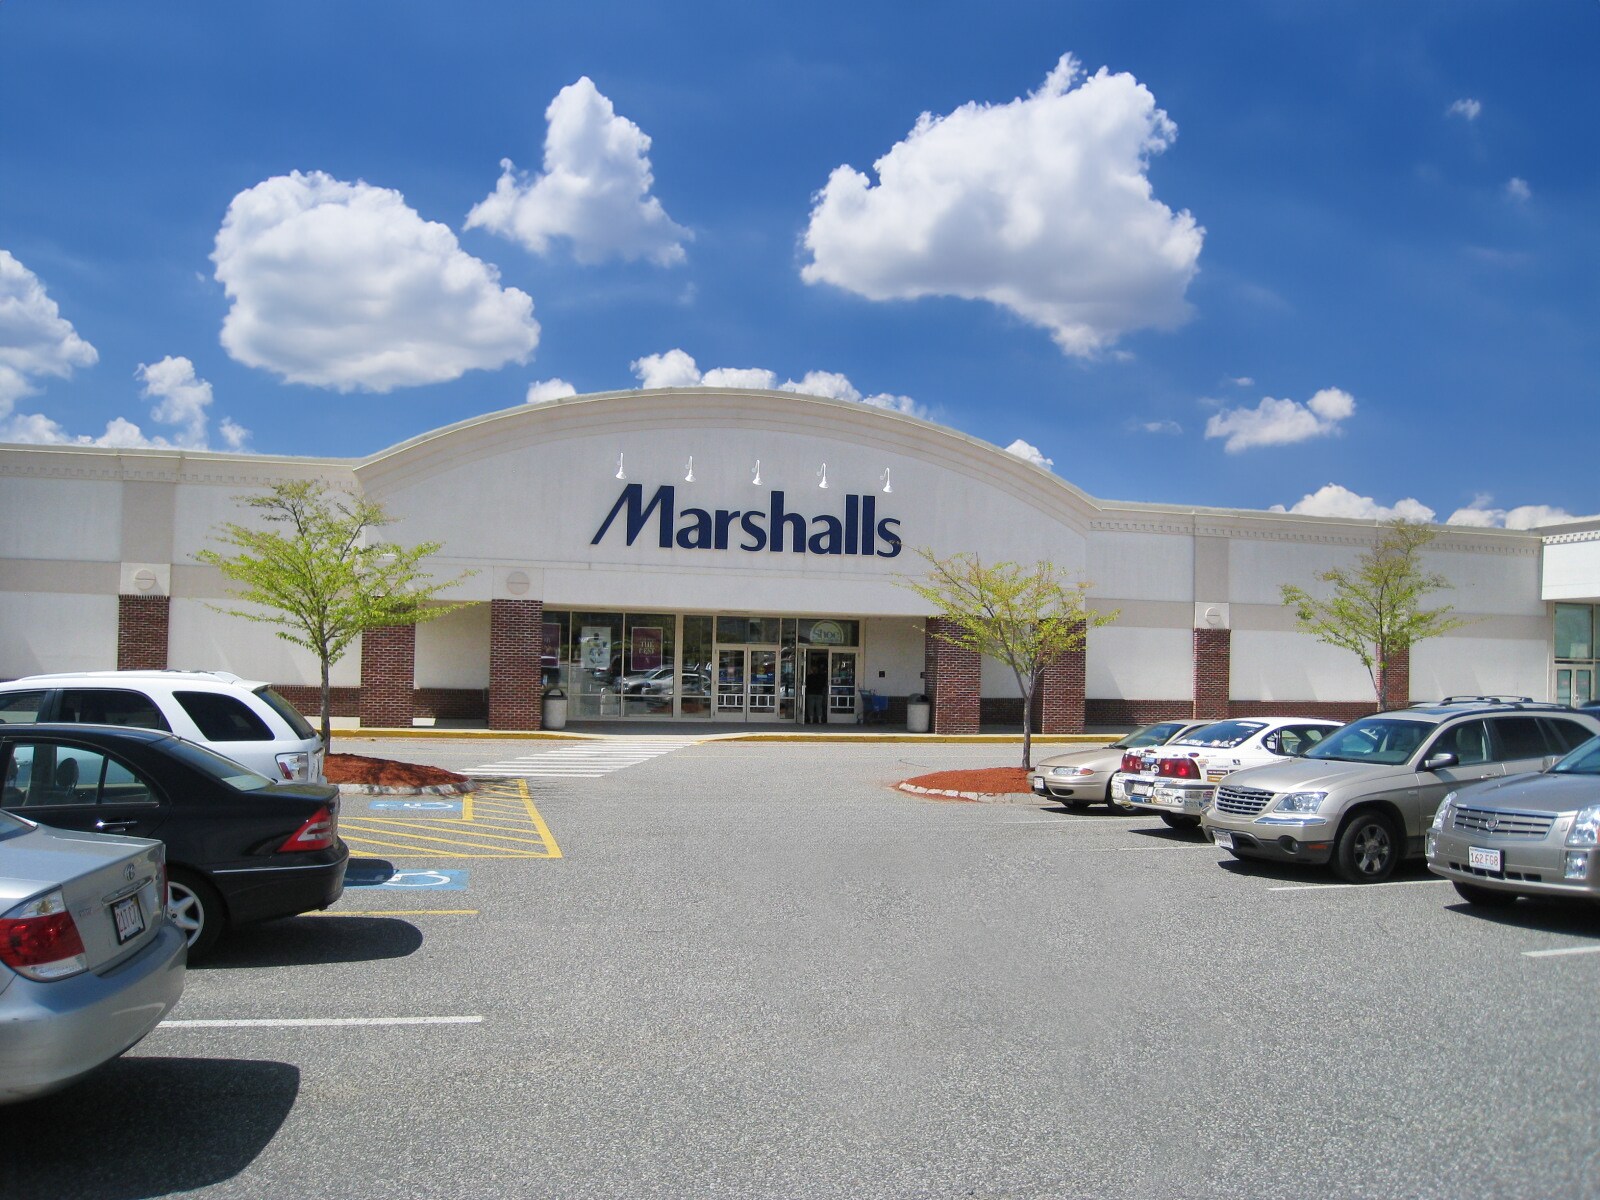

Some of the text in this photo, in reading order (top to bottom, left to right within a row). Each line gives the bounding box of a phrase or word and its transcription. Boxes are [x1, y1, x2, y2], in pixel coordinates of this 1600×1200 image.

[590, 483, 903, 558] Marshalls
[1470, 853, 1499, 866] 162 FG8
